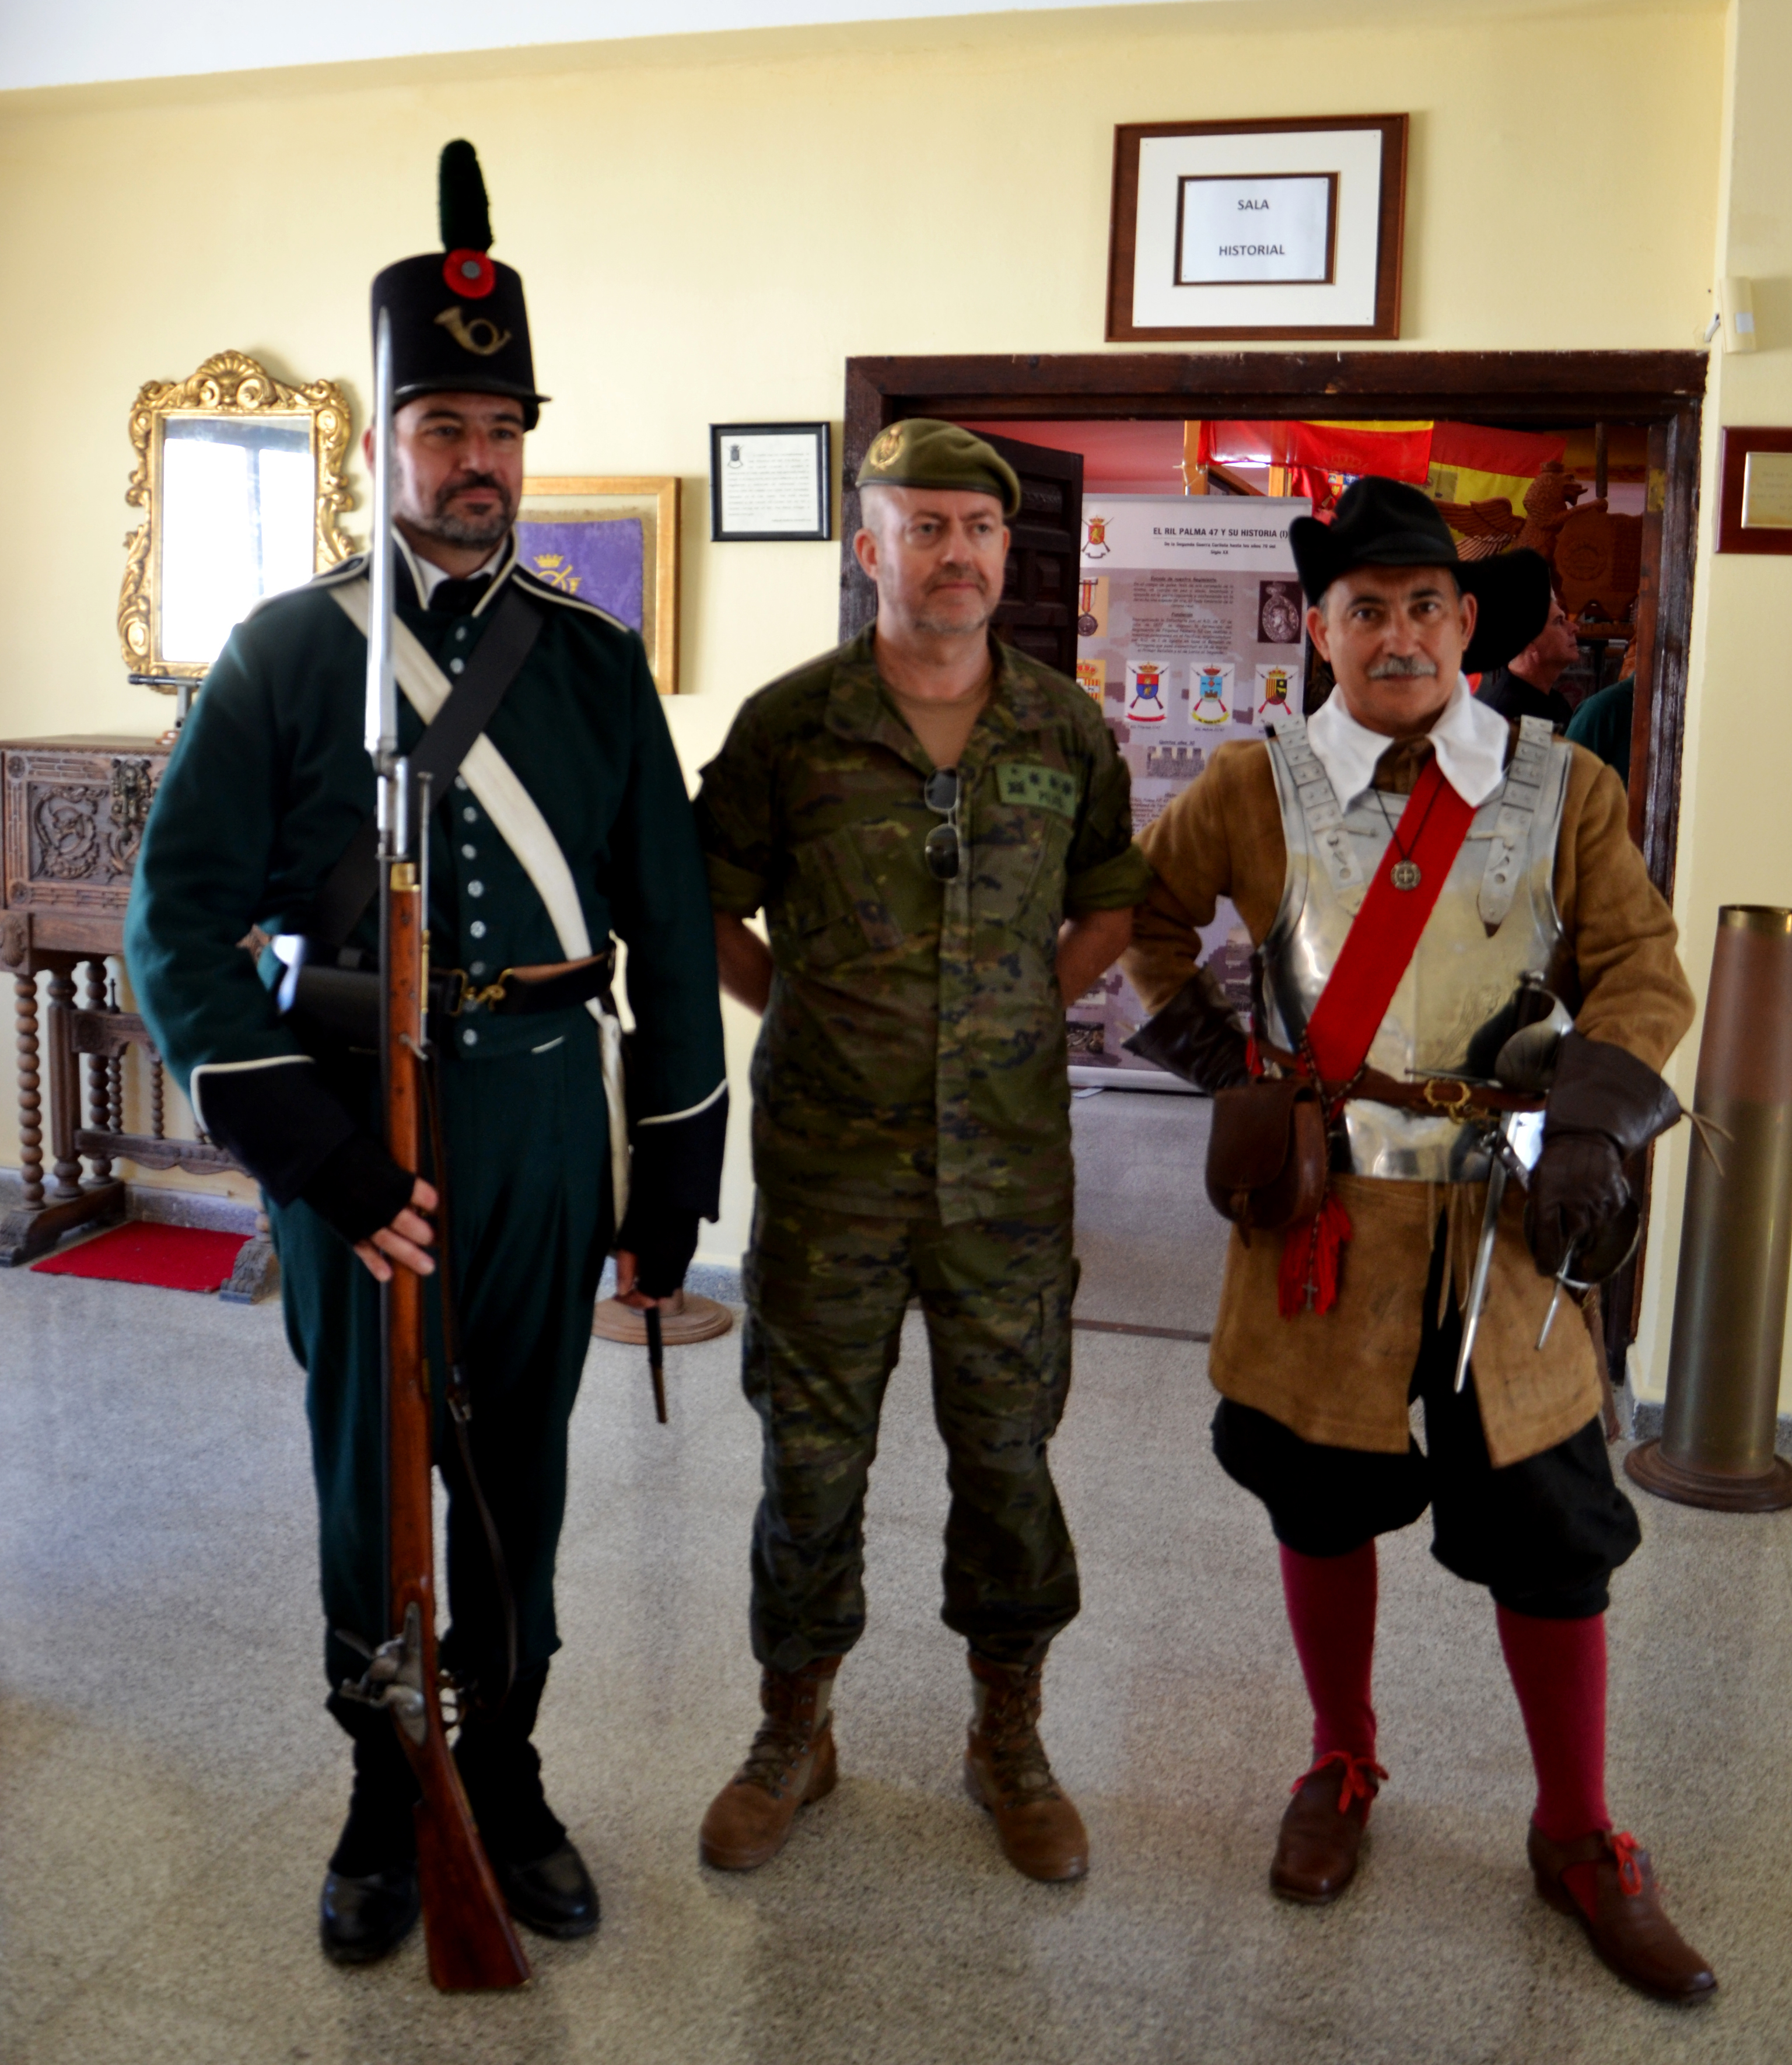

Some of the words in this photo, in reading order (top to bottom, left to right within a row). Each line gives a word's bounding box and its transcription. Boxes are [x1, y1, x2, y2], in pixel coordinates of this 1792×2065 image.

[1238, 199, 1269, 211] SALA
[1219, 244, 1285, 256] HISTORIAL
[1241, 529, 1277, 537] HISTORIA
[1279, 530, 1288, 538] (I)
